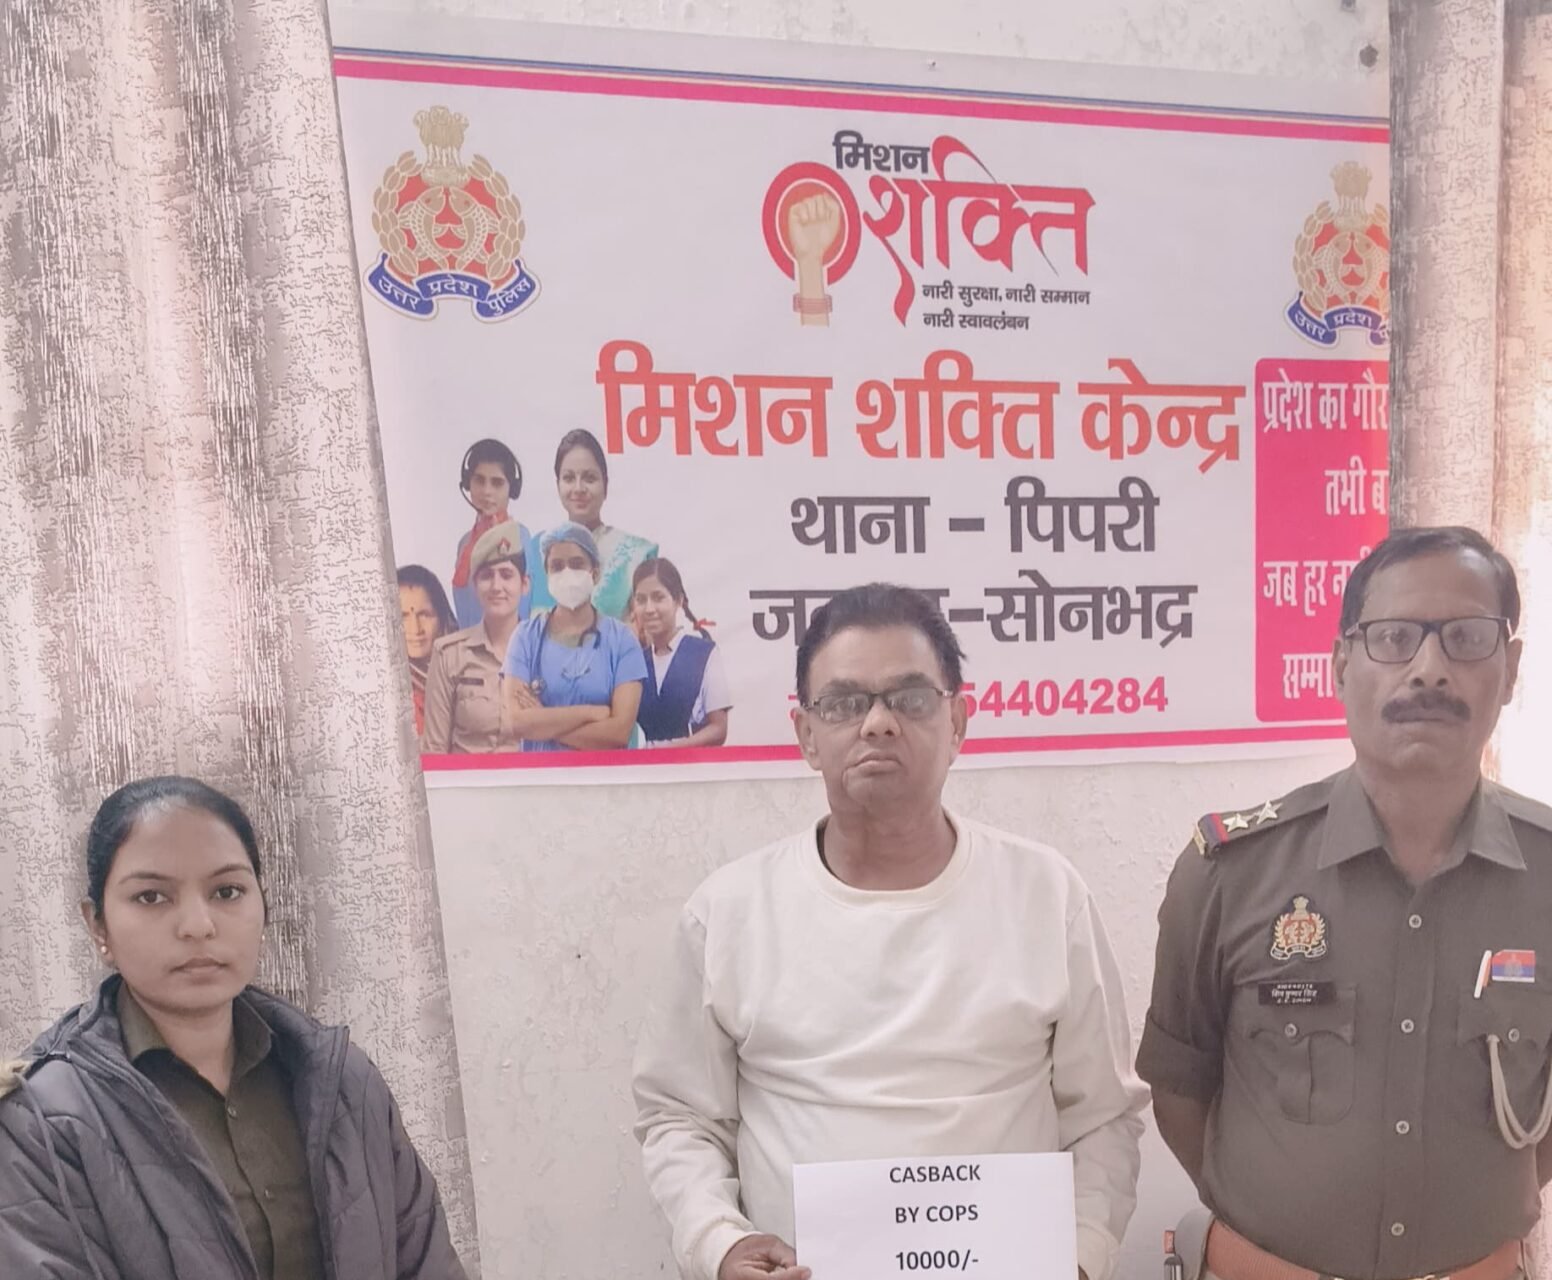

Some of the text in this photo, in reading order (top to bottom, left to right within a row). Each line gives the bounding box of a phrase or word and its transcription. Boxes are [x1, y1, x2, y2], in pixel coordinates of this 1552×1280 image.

[832, 129, 931, 174] मिशन
[862, 135, 1096, 327] शक्ति
[378, 274, 531, 316] उत्तर प्रदेश पुलिस
[922, 280, 954, 300] नारी
[1005, 283, 1036, 303] नारी
[1040, 289, 1091, 305] सम्मान
[923, 308, 1030, 331] नारी स्वावलंबन
[596, 339, 1247, 474] मिशन शक्ति केन्द्र
[1262, 368, 1390, 433] प्रदेश का गौर
[1324, 455, 1367, 516] तभी
[790, 496, 931, 554] थाना
[1004, 475, 1160, 554] पिपरी
[1263, 561, 1299, 607] जब
[1303, 560, 1328, 616] हर
[960, 676, 1169, 720] 54404284
[1282, 653, 1334, 699] सम्मा
[889, 1164, 981, 1183] CASBACK
[895, 1204, 979, 1223] BY COPS
[895, 1249, 979, 1271] 10000/-
